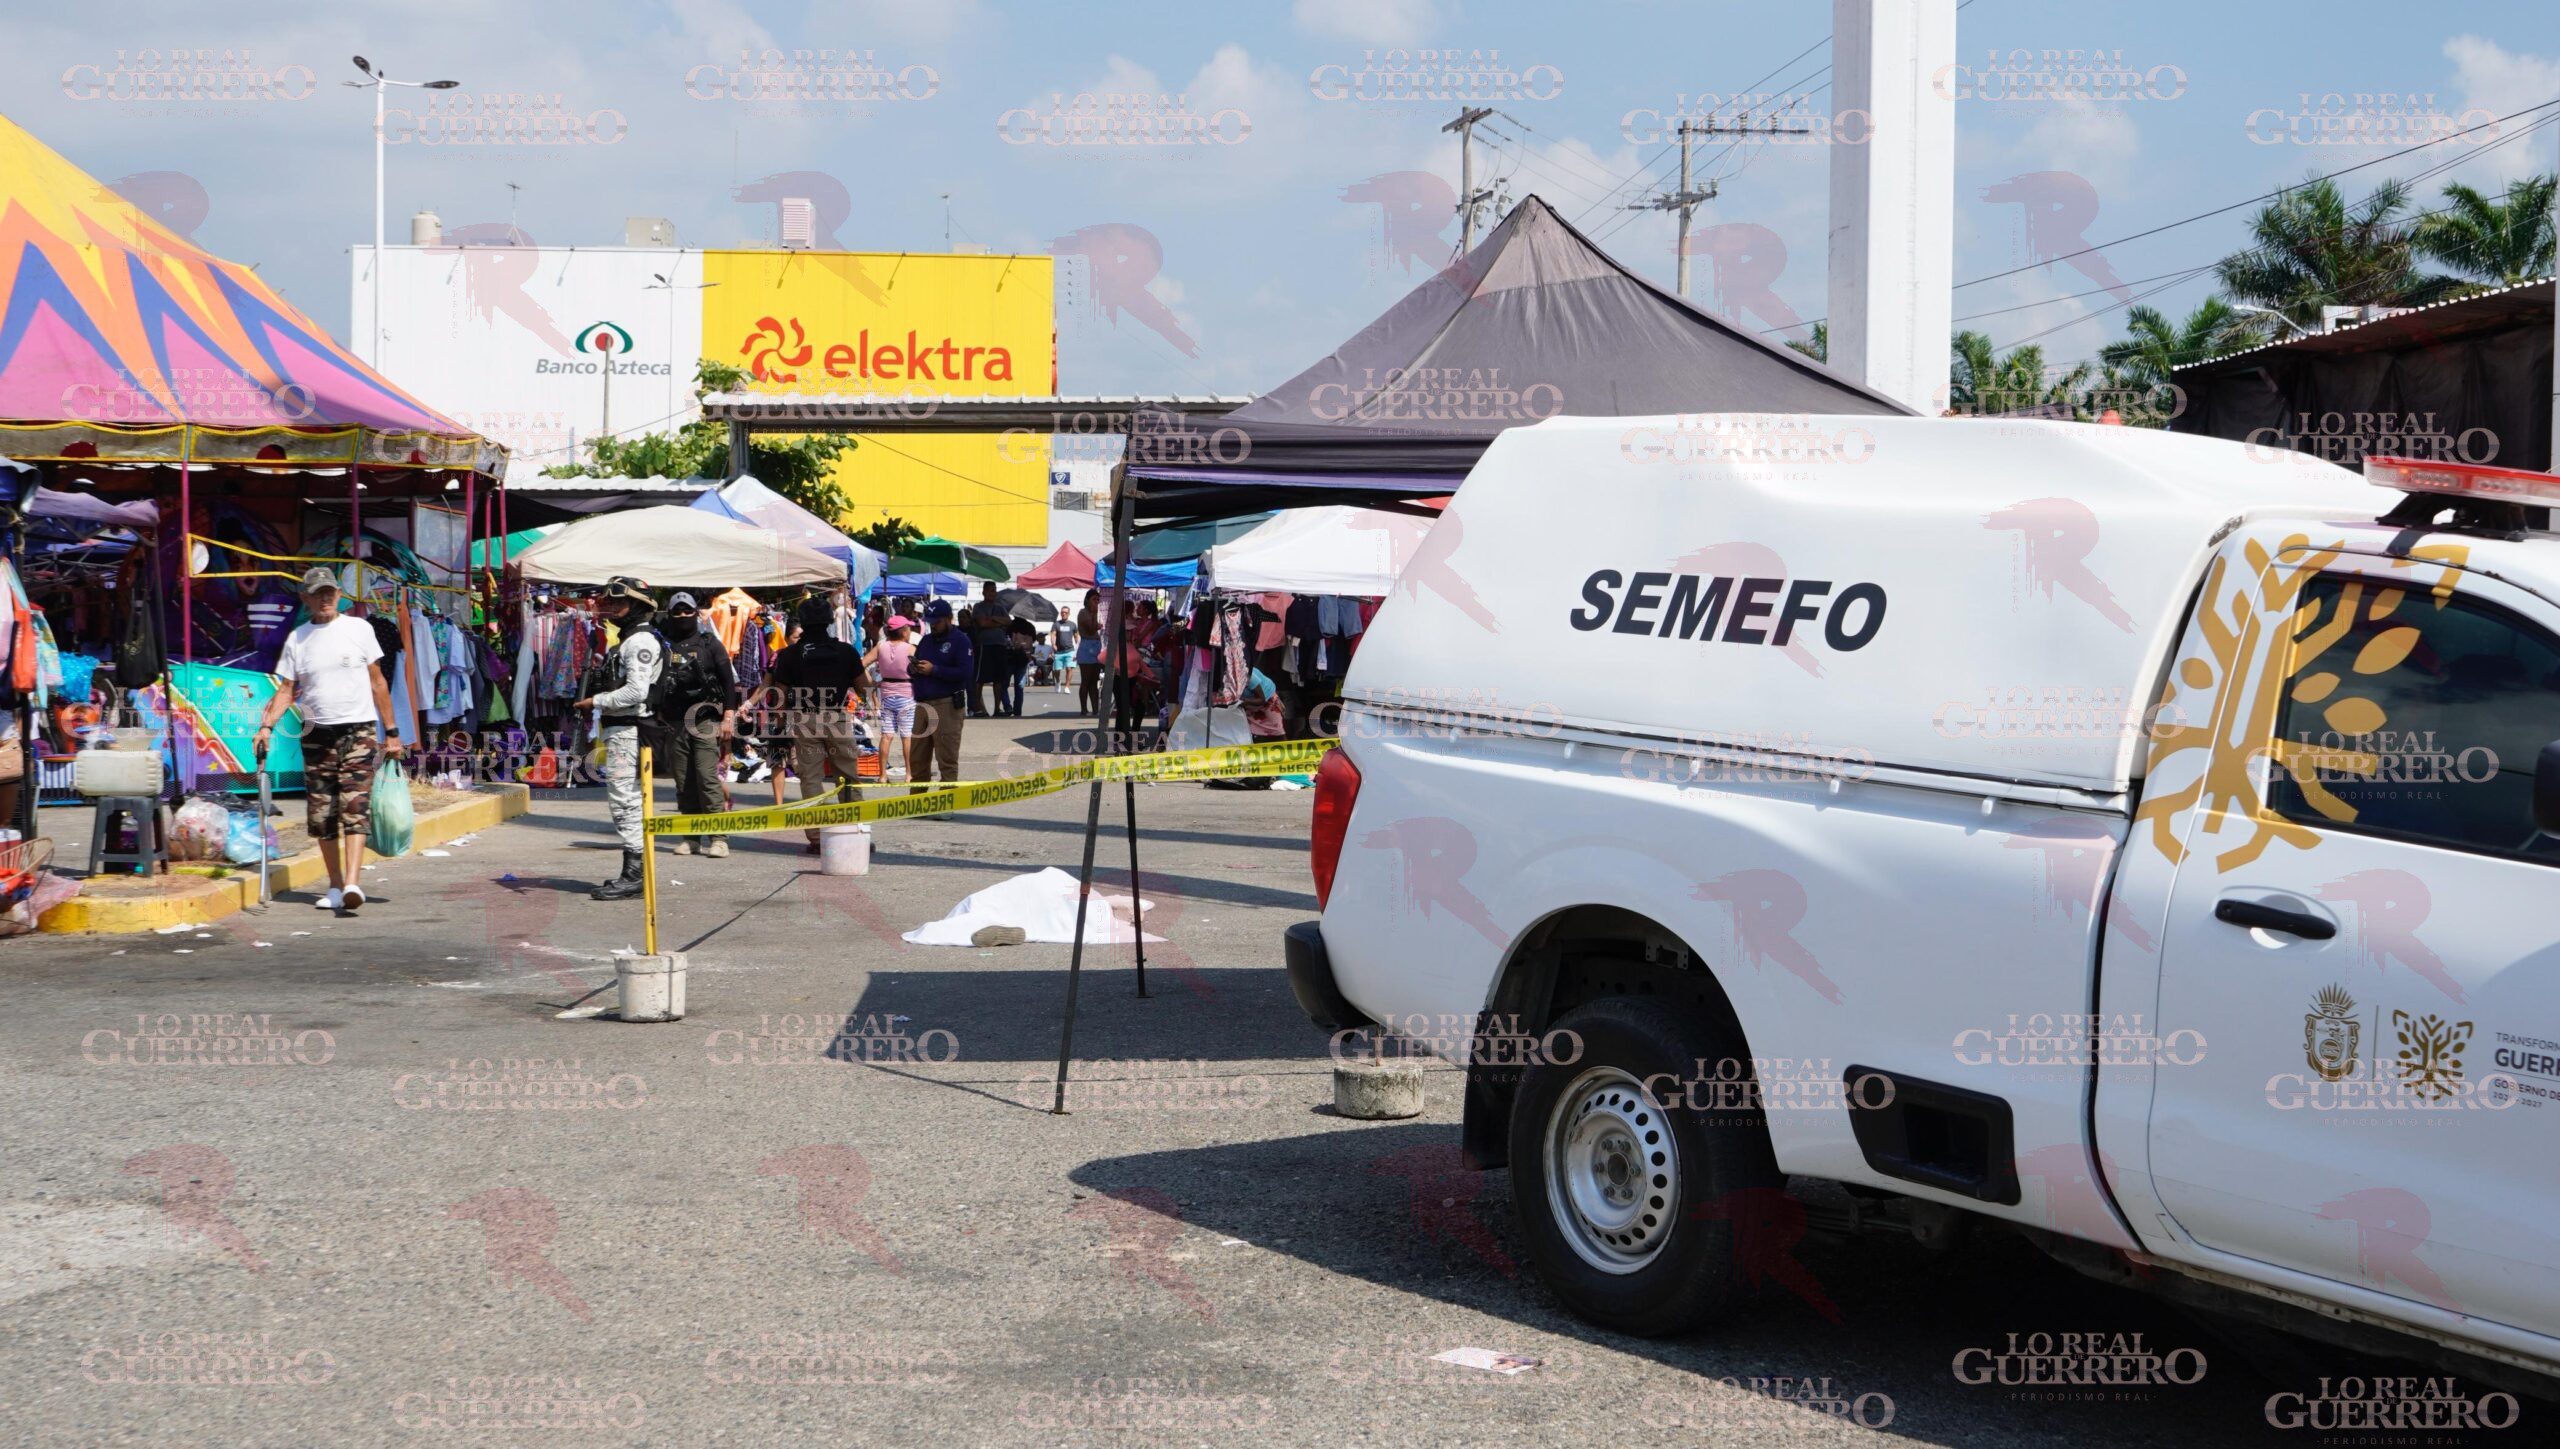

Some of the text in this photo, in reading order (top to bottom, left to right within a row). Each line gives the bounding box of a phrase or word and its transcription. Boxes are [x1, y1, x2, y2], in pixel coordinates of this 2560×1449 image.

[536, 358, 672, 376] Banco Azteca
[823, 328, 1013, 382] elektra
[1570, 568, 1888, 652] SEMEFO
[2495, 1079, 2547, 1097] GOBERNO
